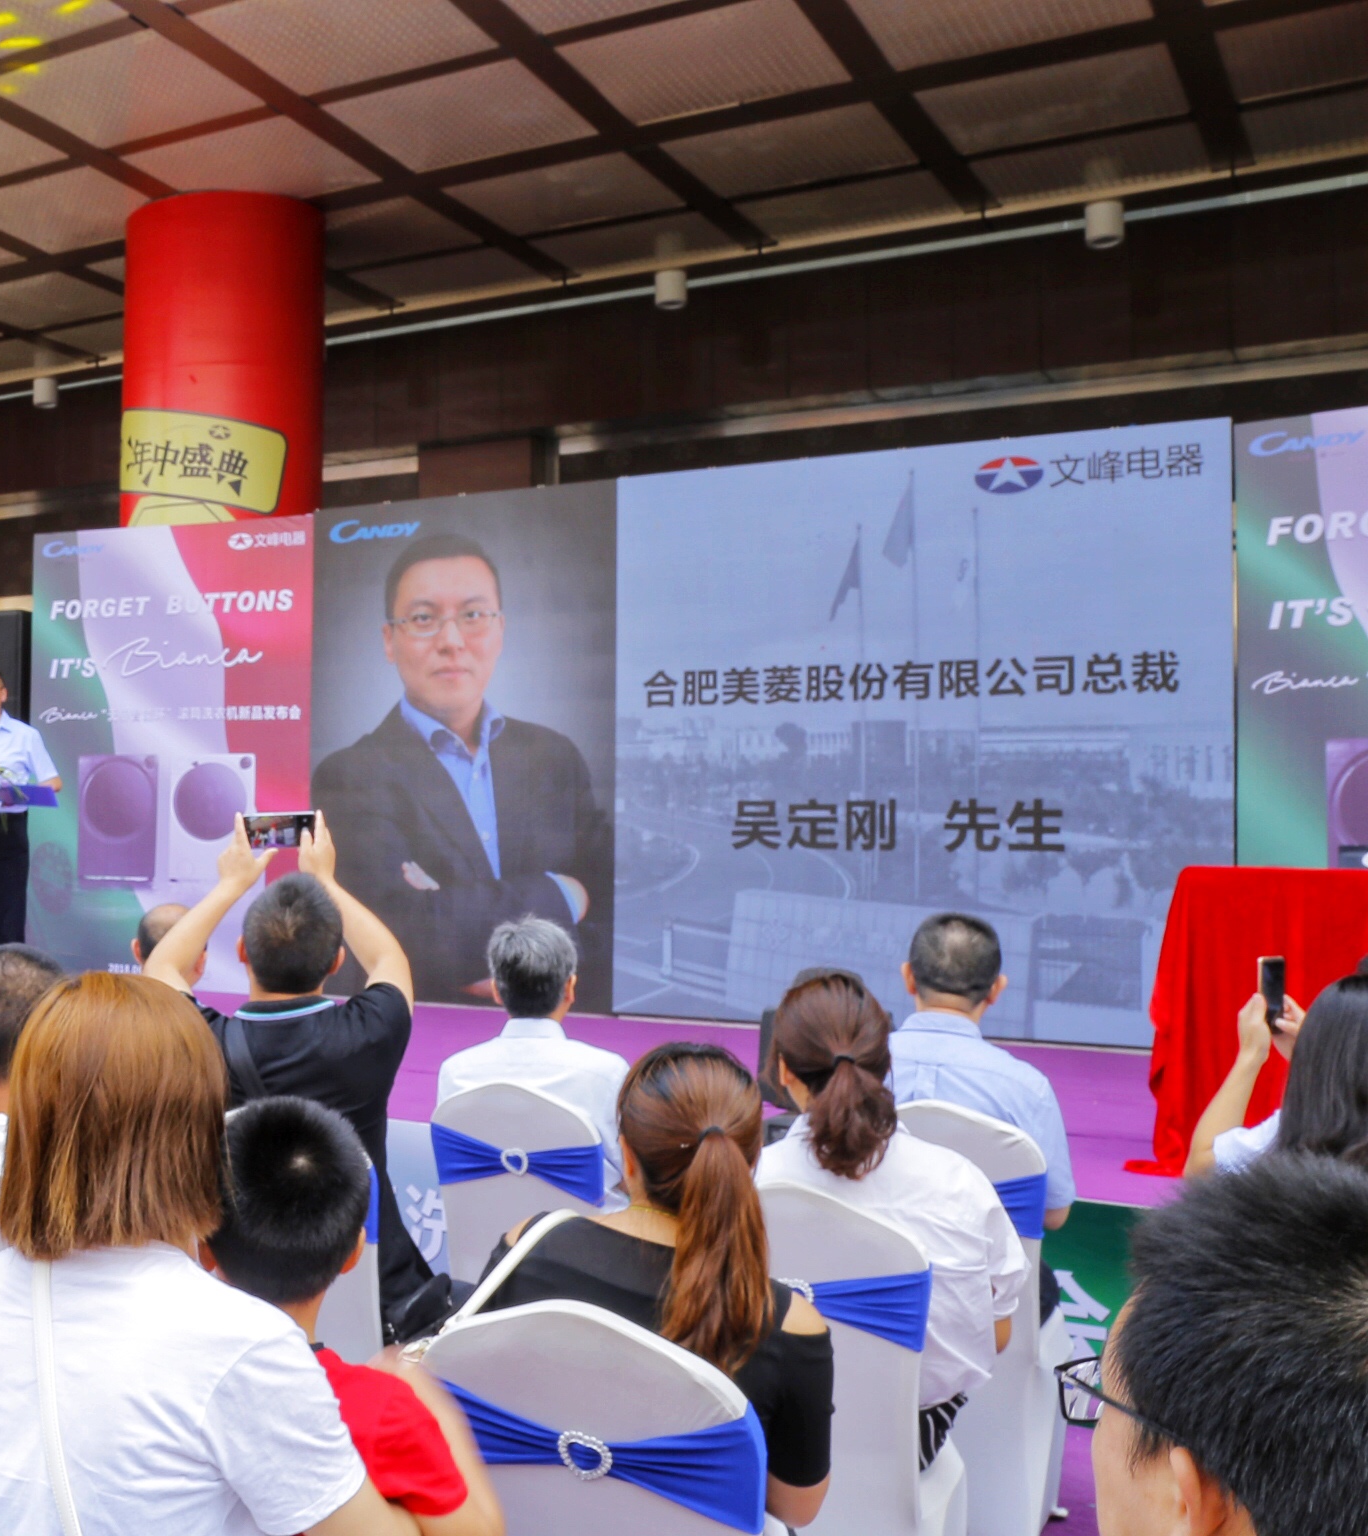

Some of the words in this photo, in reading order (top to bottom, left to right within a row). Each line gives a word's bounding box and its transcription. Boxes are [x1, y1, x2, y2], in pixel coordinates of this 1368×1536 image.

[1248, 430, 1366, 457] CANDY
[126, 438, 249, 497] 年中盛典
[1049, 442, 1204, 488] 文峰电器
[253, 530, 306, 549] 文峰电器
[329, 519, 421, 543] CANDY
[50, 596, 151, 620] FORGET
[166, 589, 294, 615] BUTTONS
[1268, 597, 1354, 630] IT'S
[49, 657, 97, 679] IT'S
[103, 637, 264, 677] Bianca
[643, 651, 1180, 709] 合肥美菱股份有限公司总裁
[1251, 670, 1360, 695] Bianca
[732, 799, 897, 852] 吴定刚
[944, 799, 1066, 854] 先生
